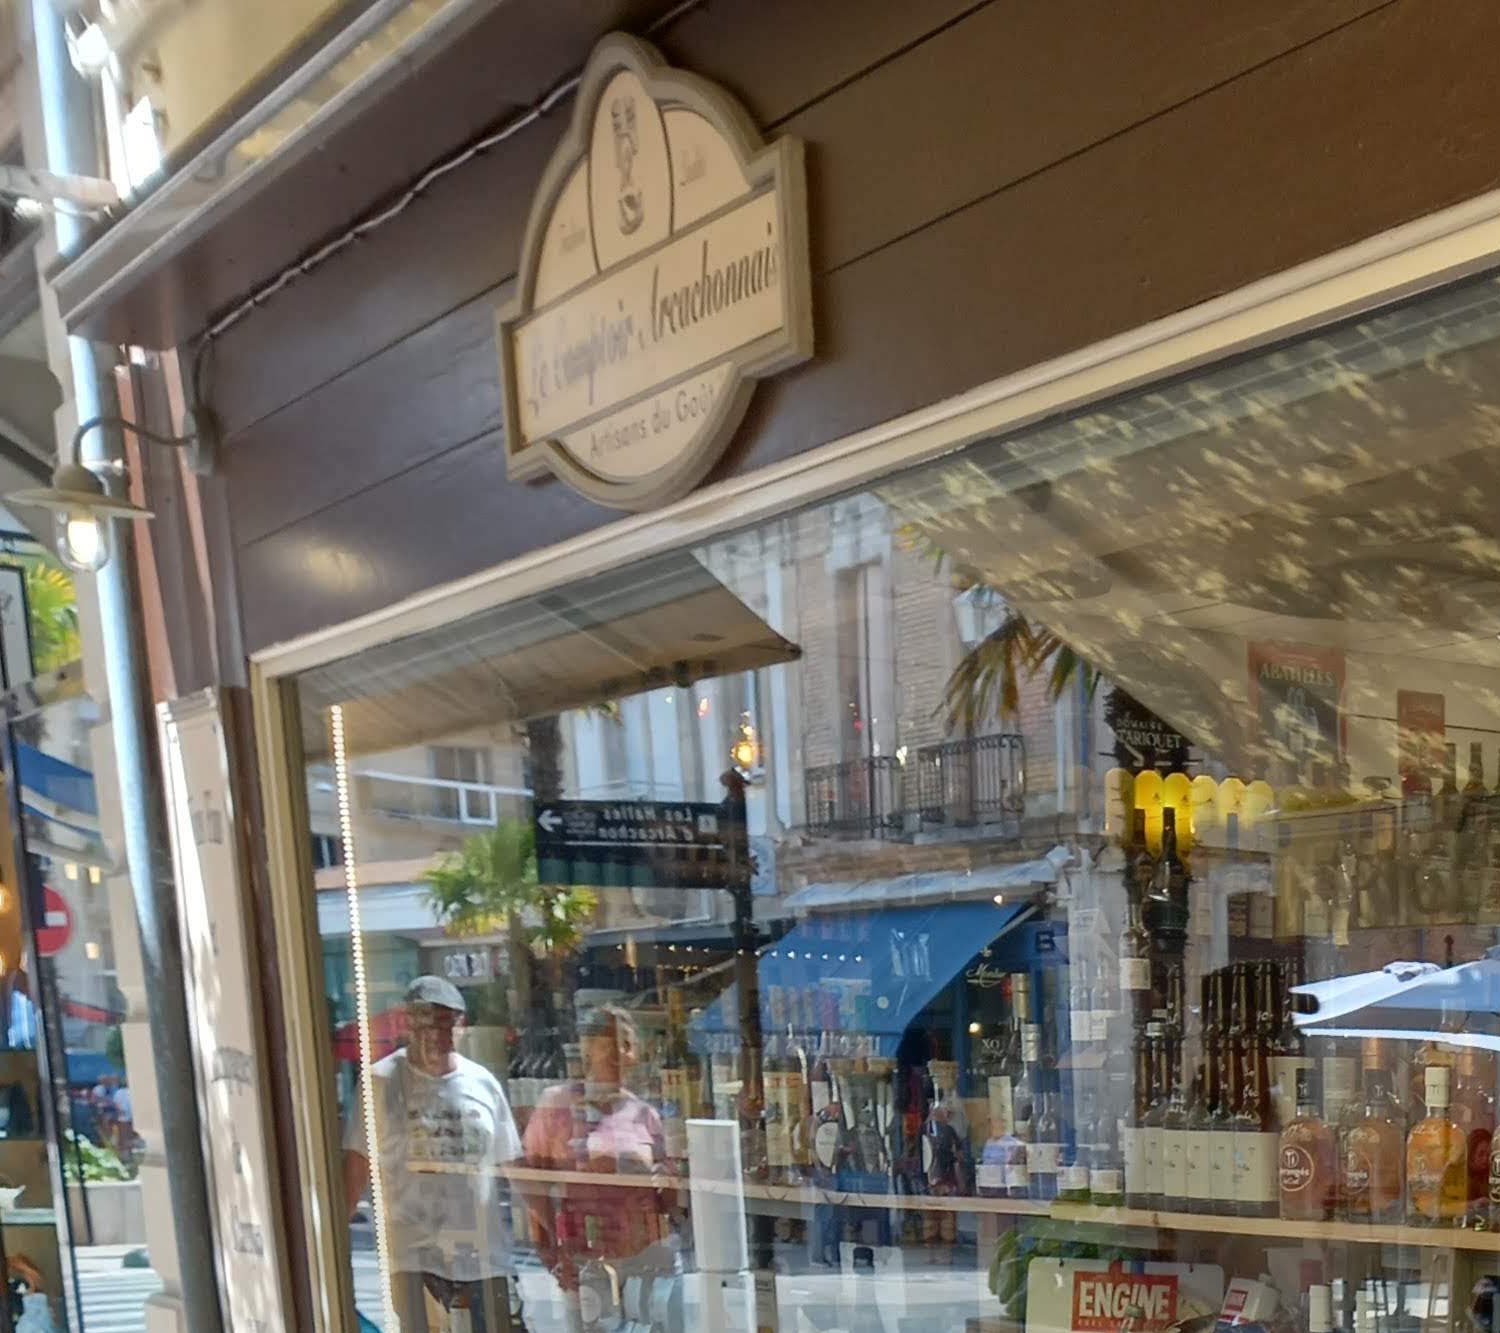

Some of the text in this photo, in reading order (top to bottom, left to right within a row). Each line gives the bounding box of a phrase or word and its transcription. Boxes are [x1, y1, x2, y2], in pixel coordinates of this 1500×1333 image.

[589, 383, 717, 459] Artisans du Goût
[1079, 1280, 1172, 1321] ENGINE
